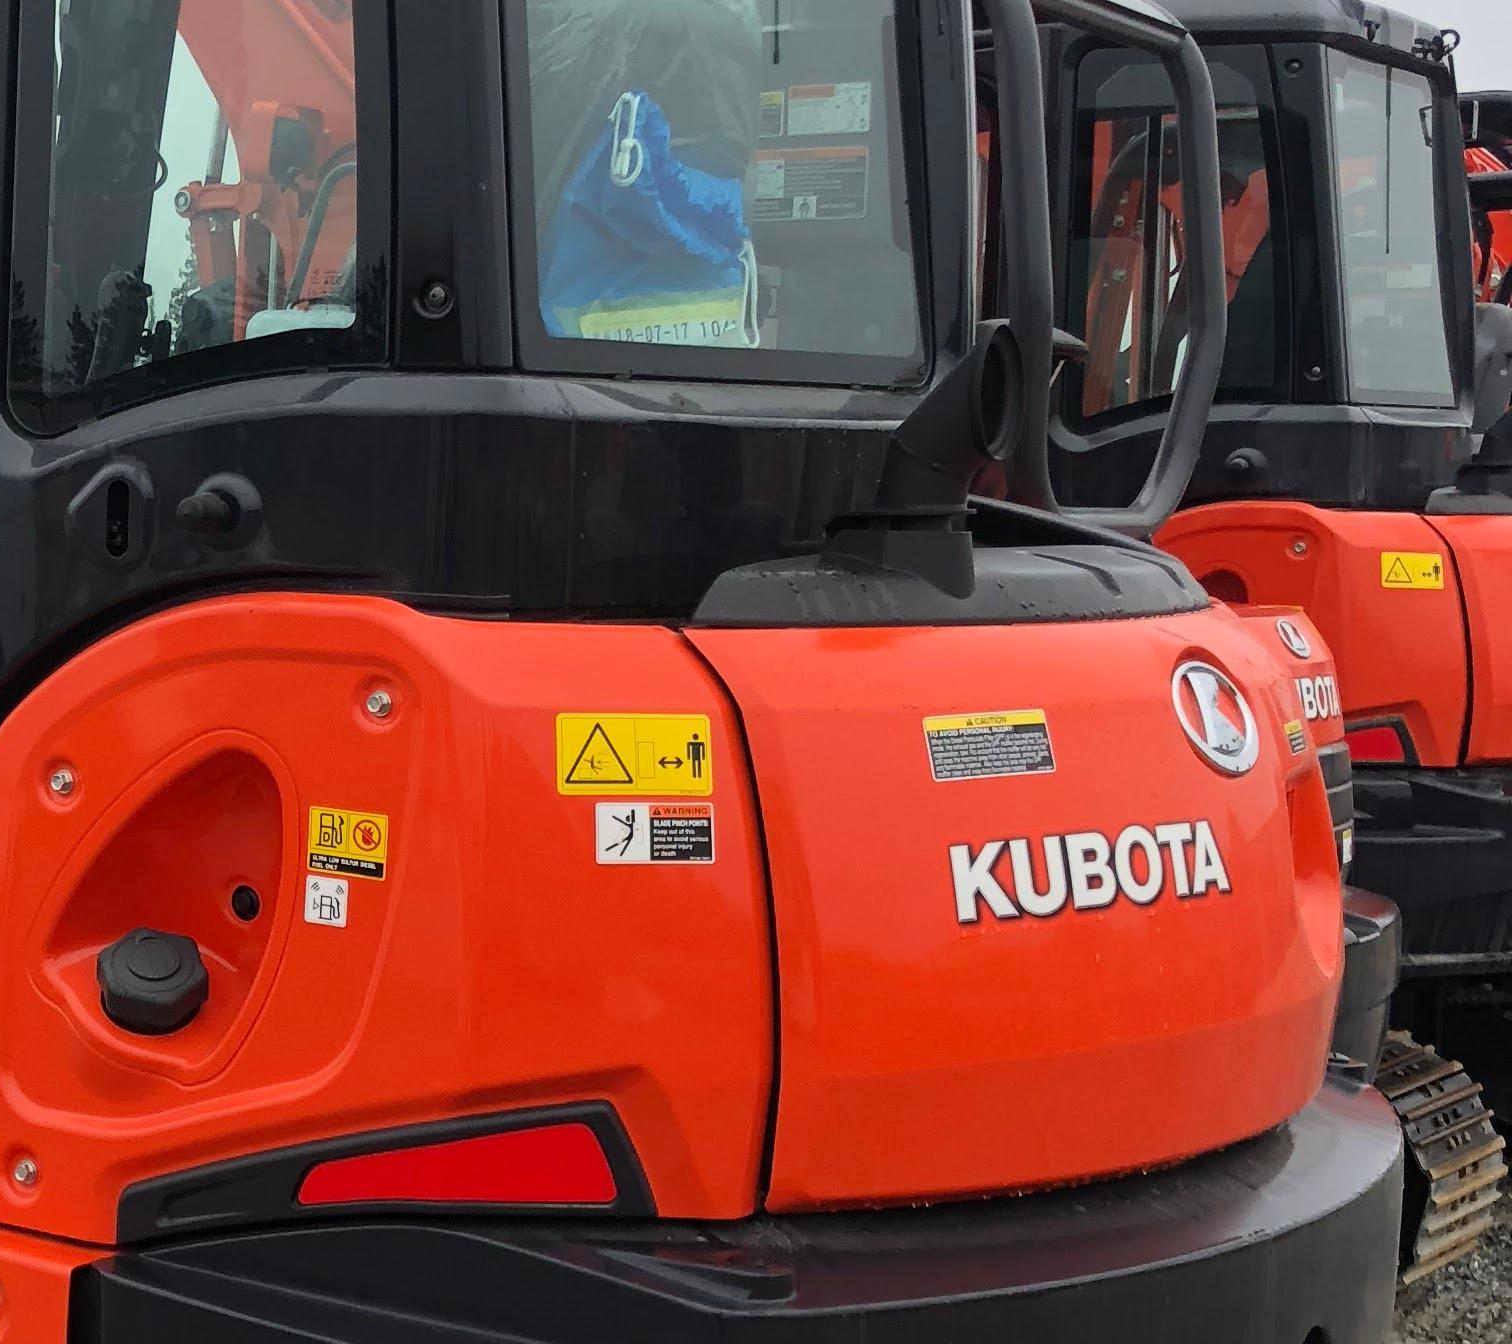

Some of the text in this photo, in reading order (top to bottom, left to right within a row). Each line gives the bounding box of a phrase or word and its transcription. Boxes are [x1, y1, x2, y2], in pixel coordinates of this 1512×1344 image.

[974, 716, 1007, 725] CAUTION
[663, 807, 708, 815] WARNING
[328, 856, 340, 864] LOW
[948, 819, 1232, 924] KUBOTA
